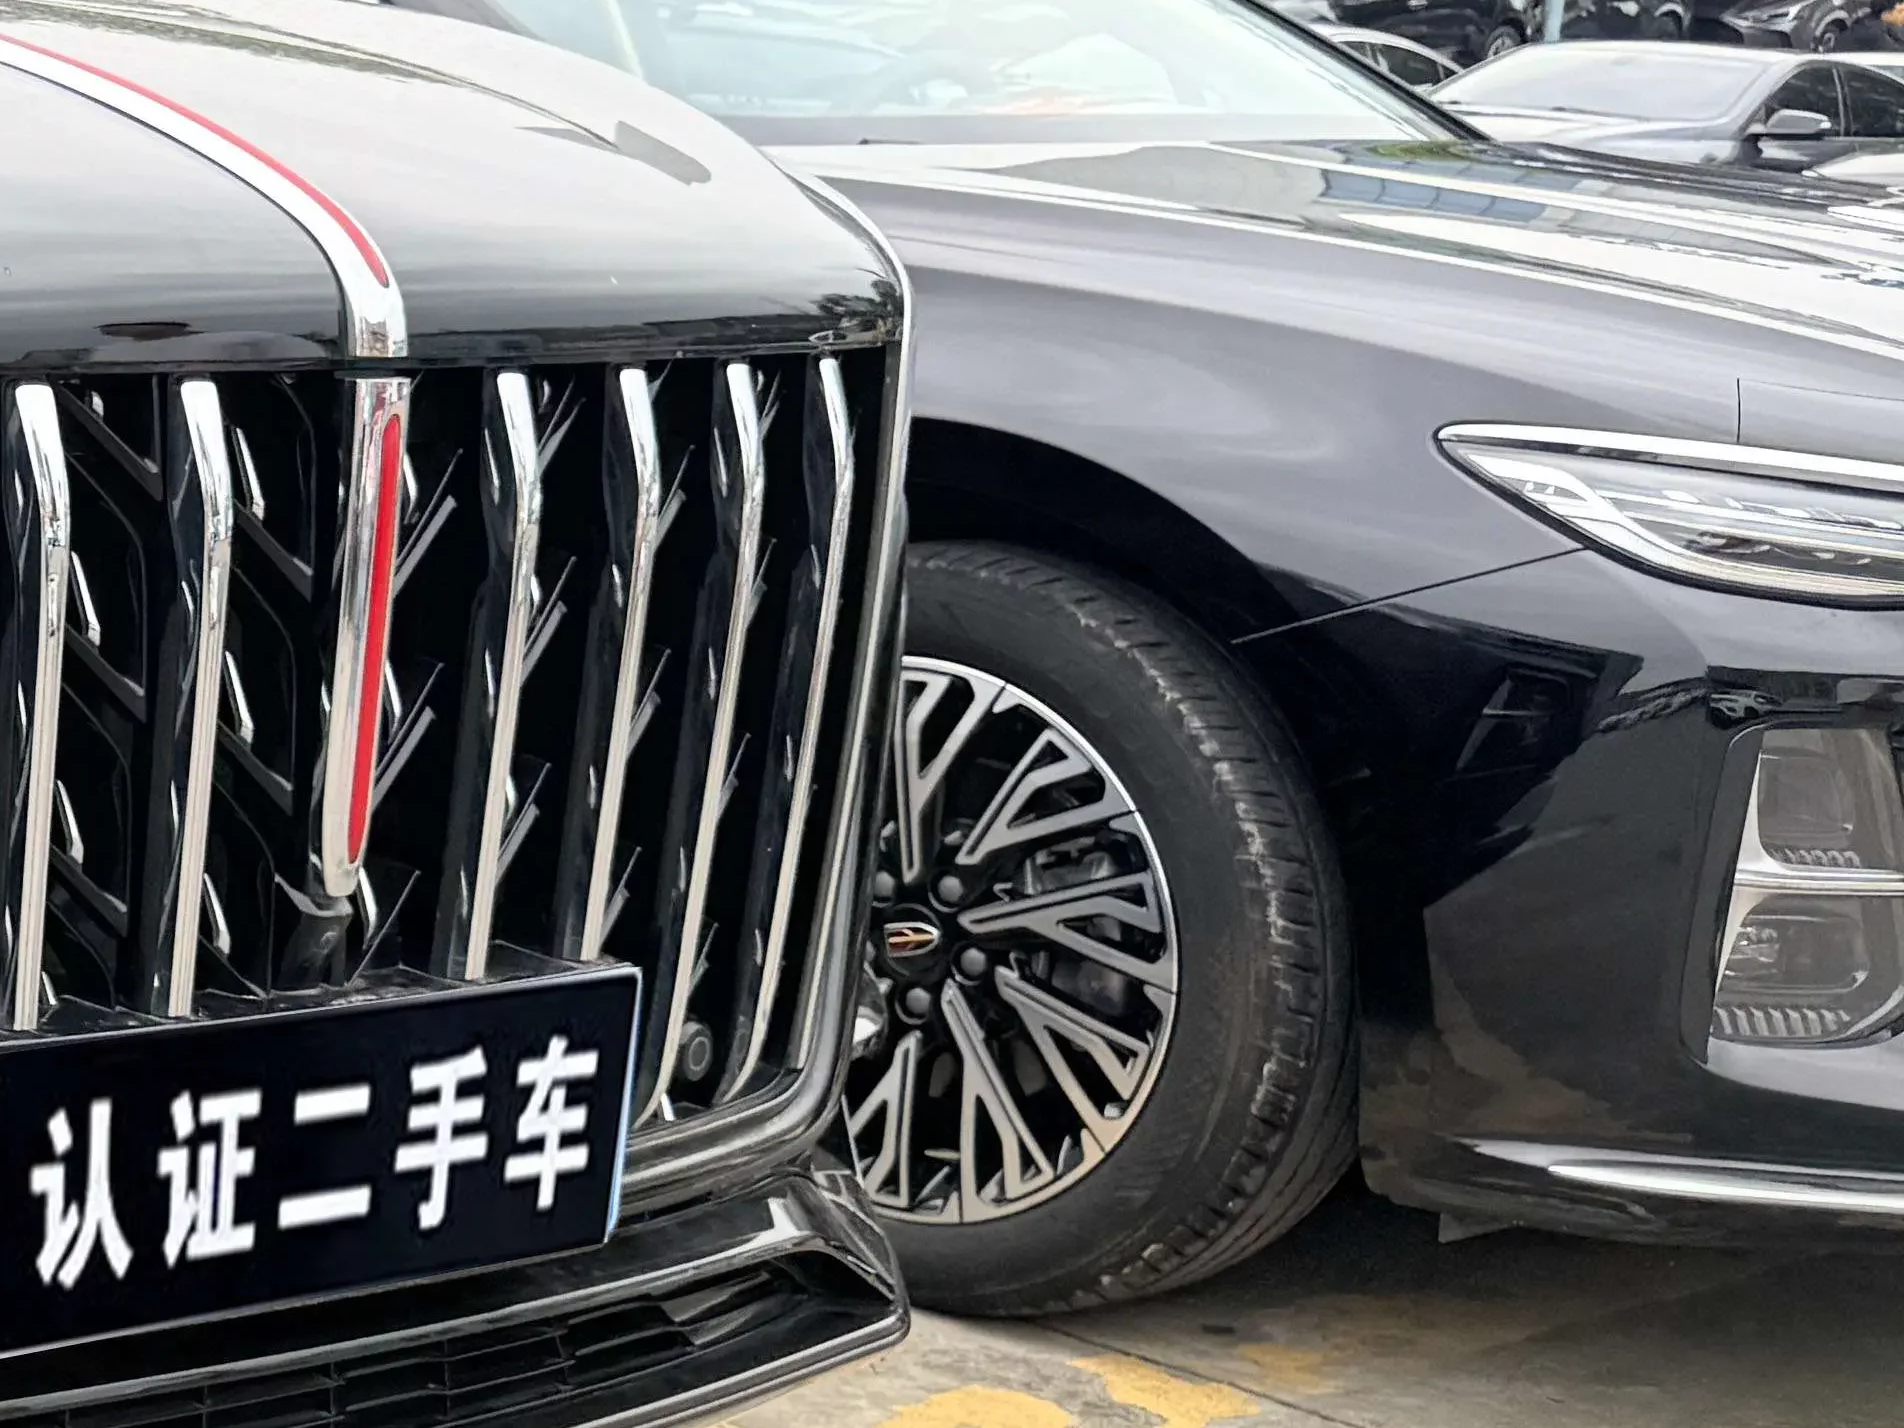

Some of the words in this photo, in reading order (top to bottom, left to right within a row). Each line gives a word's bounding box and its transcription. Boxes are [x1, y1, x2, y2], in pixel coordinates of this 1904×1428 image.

[29, 1034, 599, 1290] 认证二手车
